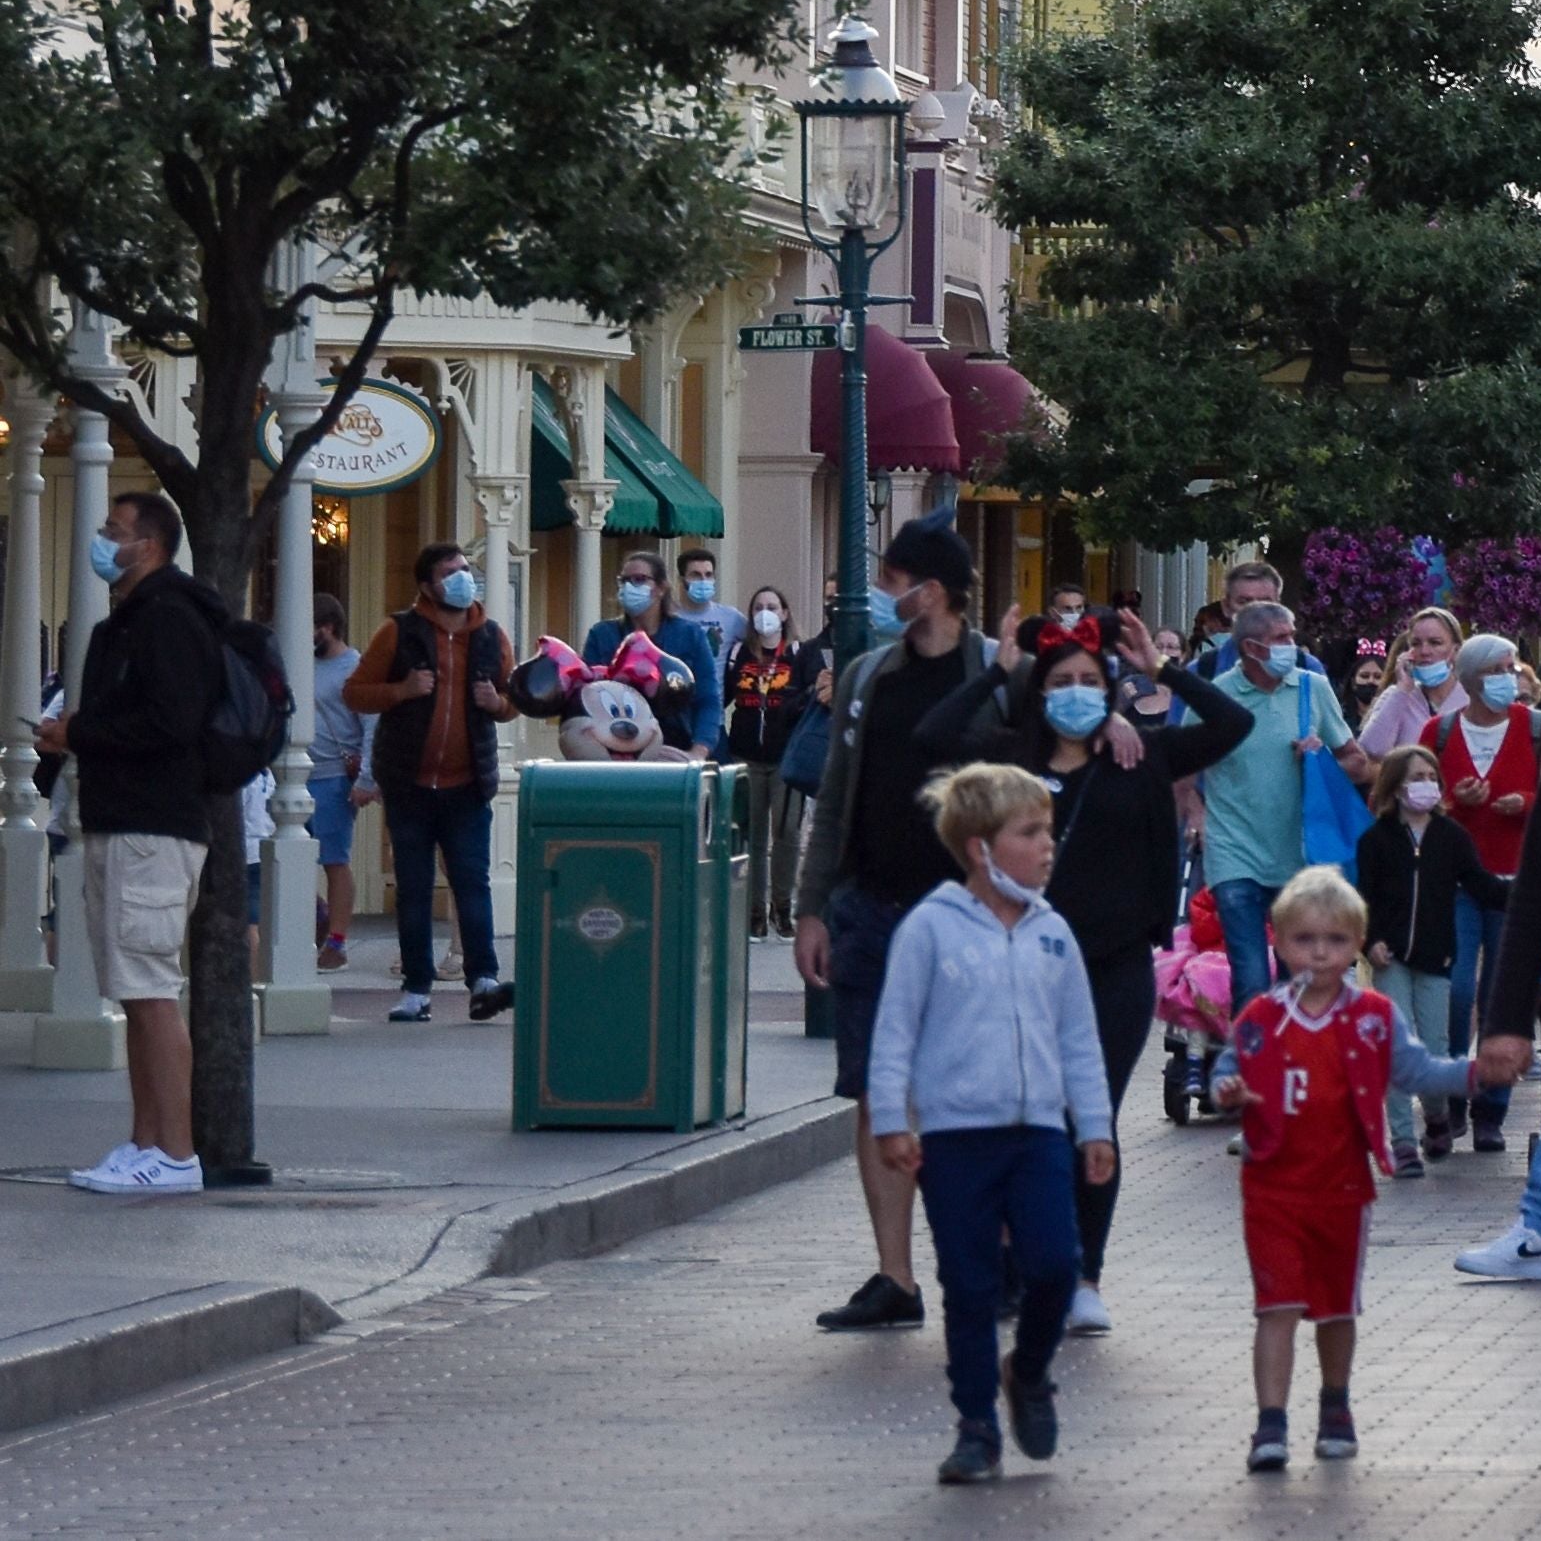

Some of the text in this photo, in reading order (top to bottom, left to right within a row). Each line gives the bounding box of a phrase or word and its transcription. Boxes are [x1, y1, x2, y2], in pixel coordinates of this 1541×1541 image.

[752, 329, 827, 347] FLOWER ST.
[311, 442, 408, 474] STAURANT
